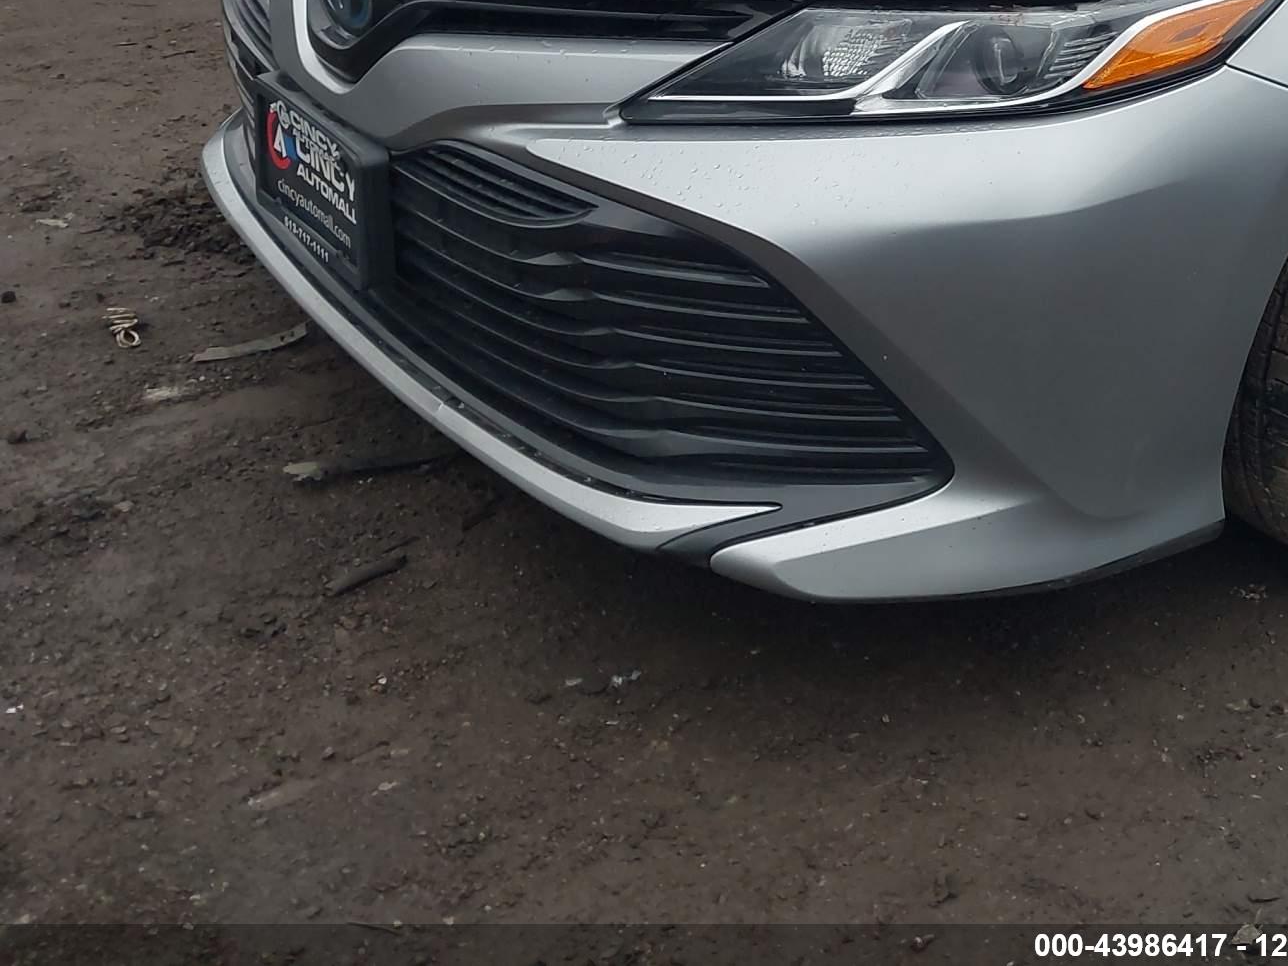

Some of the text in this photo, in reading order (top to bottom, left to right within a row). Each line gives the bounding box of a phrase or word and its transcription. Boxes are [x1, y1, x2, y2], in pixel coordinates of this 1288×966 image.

[295, 134, 355, 202] CINCY
[296, 163, 357, 225] AUTOMALL
[277, 178, 352, 249] cincyautomall.com
